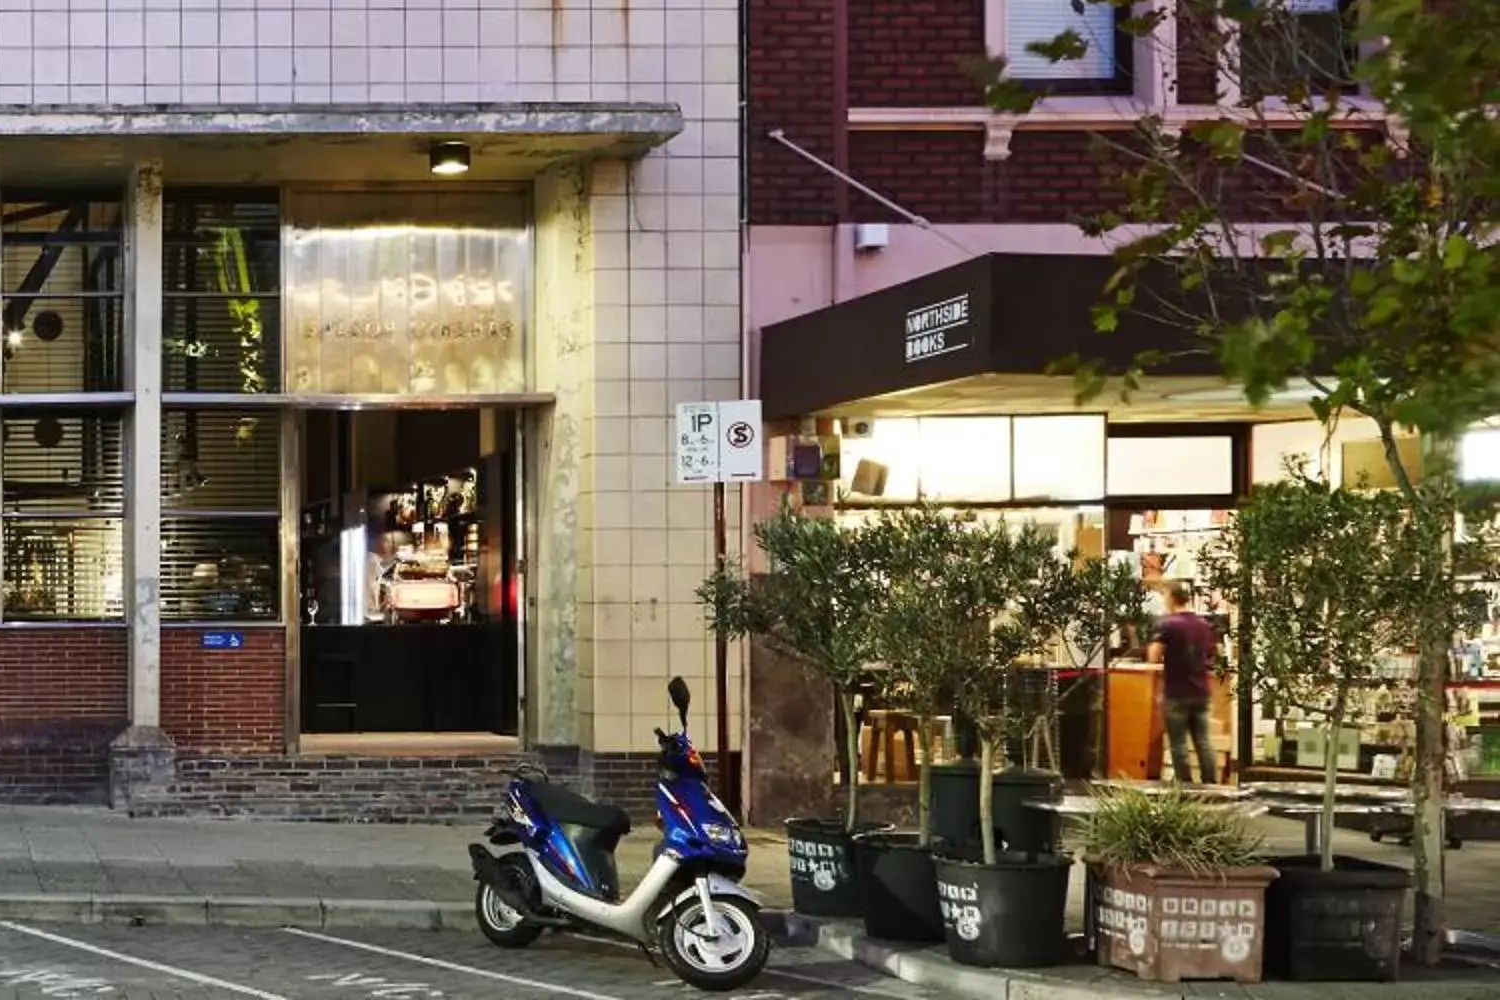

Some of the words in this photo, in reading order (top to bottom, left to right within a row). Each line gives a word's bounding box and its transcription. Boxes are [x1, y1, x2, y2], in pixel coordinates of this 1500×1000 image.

[906, 299, 968, 334] NORTHSIDE
[906, 331, 945, 358] BOOKS
[692, 413, 713, 433] 1P
